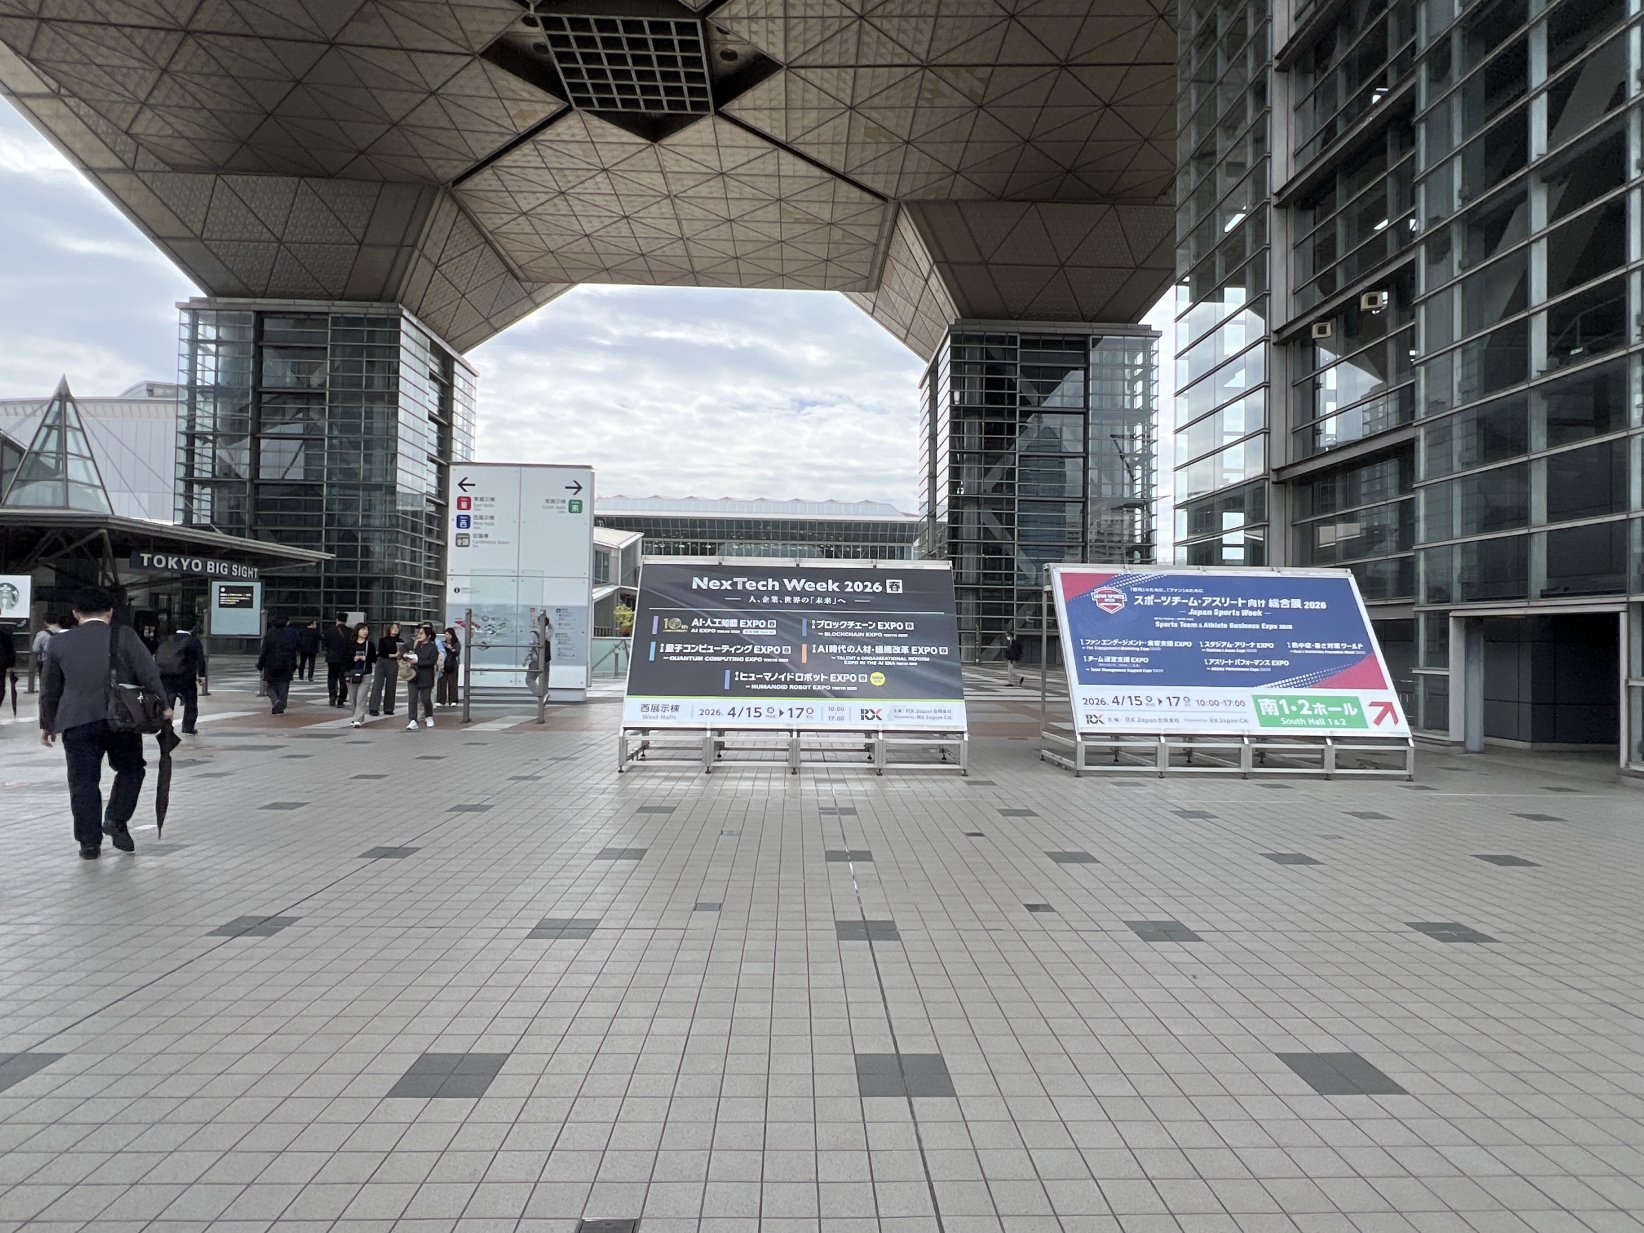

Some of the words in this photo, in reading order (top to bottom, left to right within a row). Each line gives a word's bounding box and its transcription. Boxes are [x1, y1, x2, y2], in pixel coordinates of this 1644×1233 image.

[140, 553, 202, 572] TOKYO
[207, 561, 228, 574] BIG
[232, 564, 259, 579] SIGHT
[692, 577, 779, 591] NexTech
[783, 578, 840, 592] Week
[844, 581, 882, 593] 2026
[887, 580, 902, 593] 春
[1188, 608, 1213, 616] Japan
[1213, 609, 1240, 617] Sports
[739, 620, 766, 628] EXPO
[817, 620, 876, 630] ブロックチェーン
[878, 621, 903, 630] EXPO
[754, 645, 780, 654] EXPO
[911, 646, 938, 655] EXPO
[740, 671, 828, 681] ヒューマノイドロボット
[830, 674, 857, 682] EXPO
[1111, 695, 1143, 706] 4/15
[1166, 696, 1181, 706] 17
[727, 706, 762, 718] 4/15
[787, 707, 805, 719] 17
[860, 708, 883, 721] RX
[1085, 714, 1105, 725] RX
[1280, 717, 1306, 725] South
